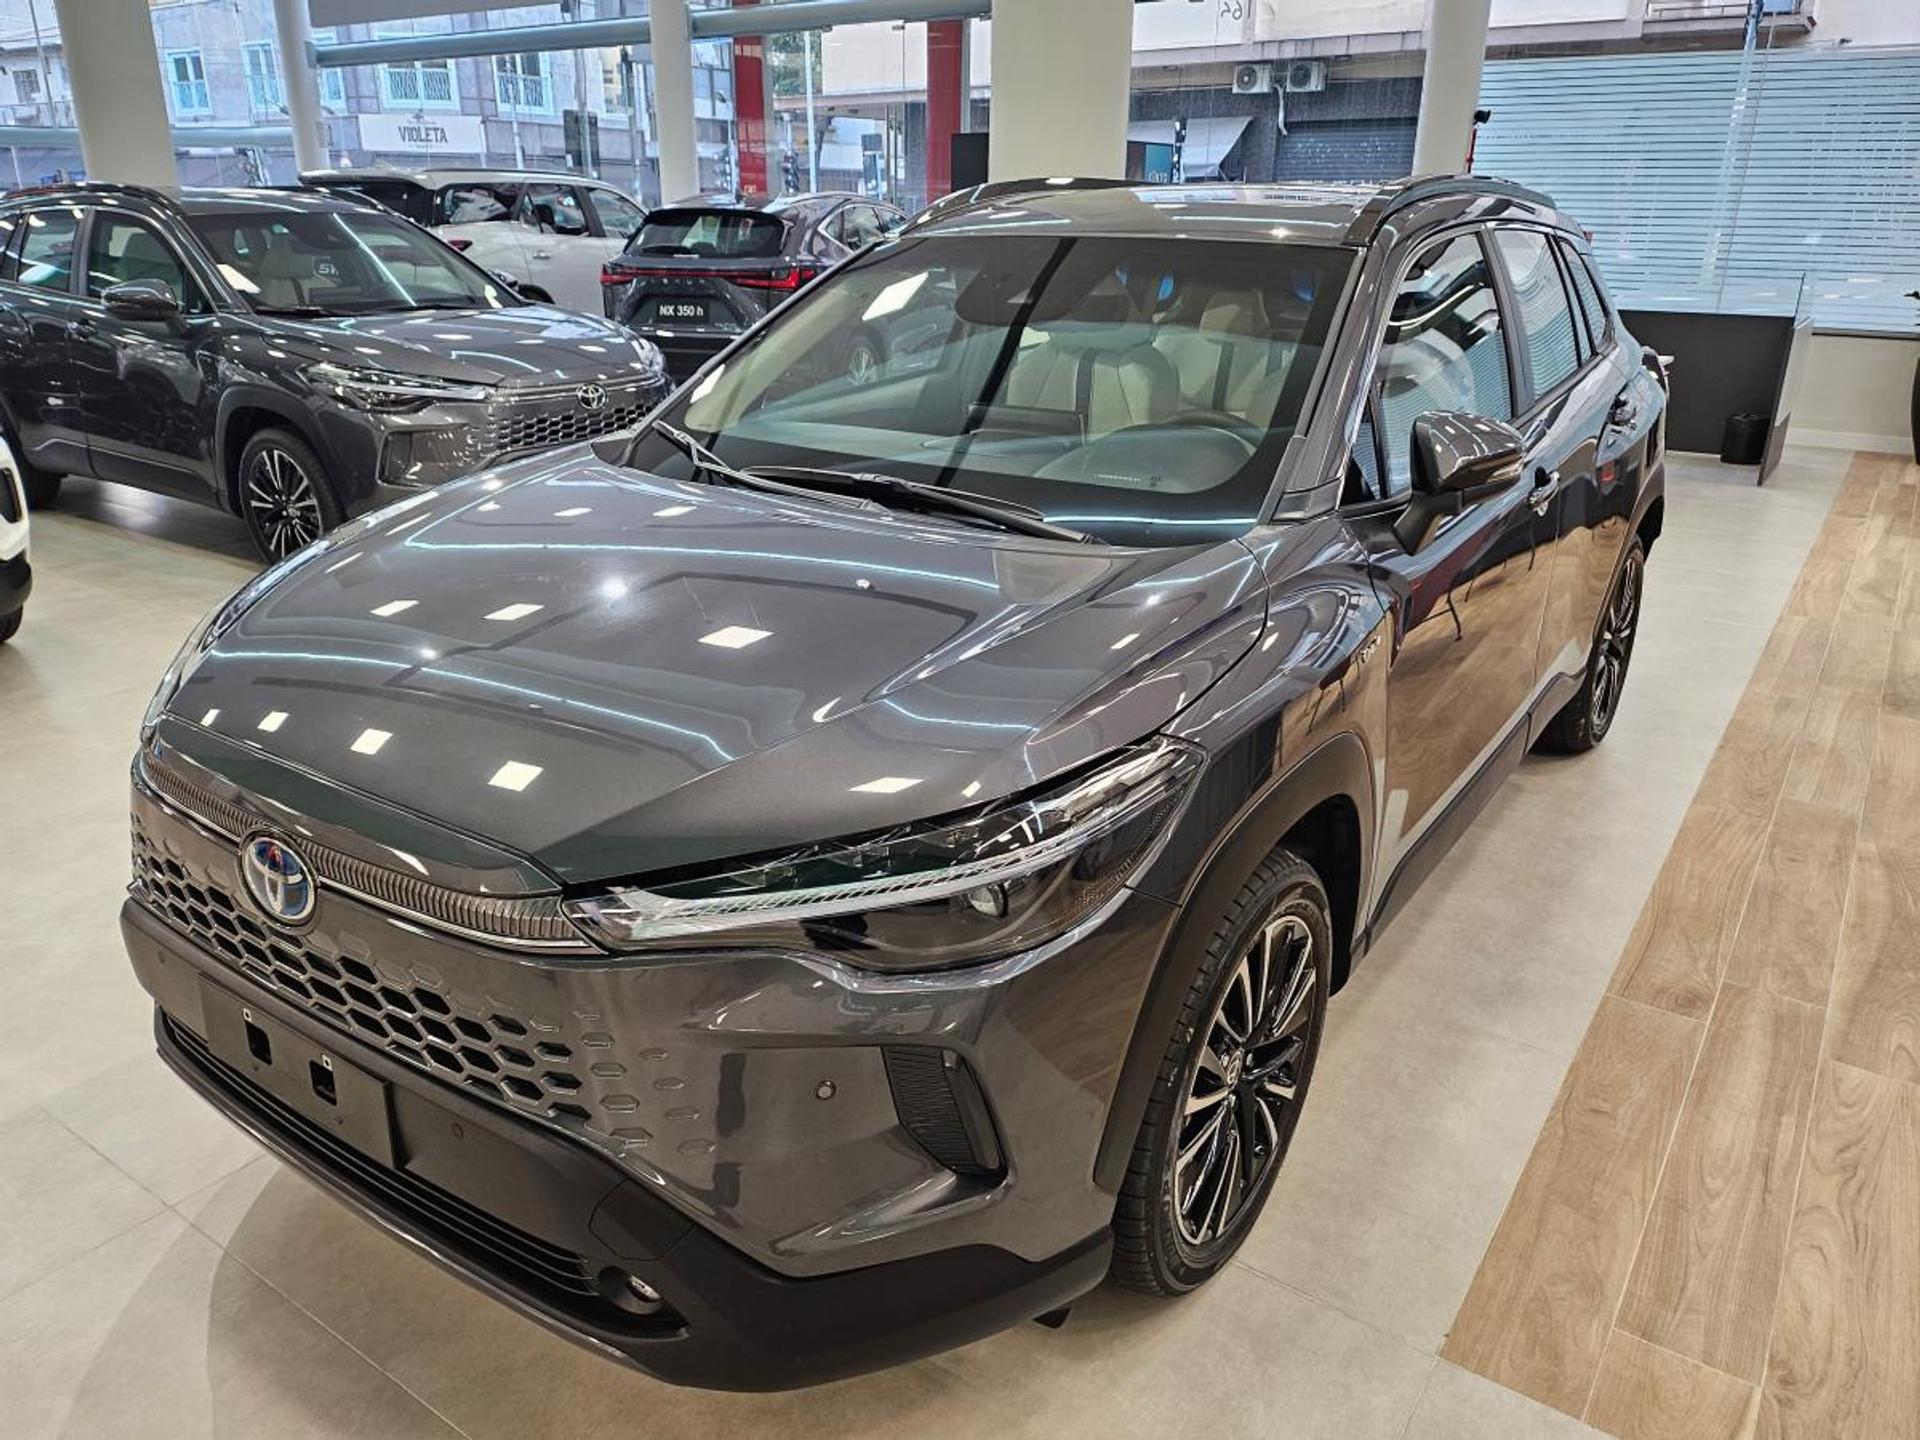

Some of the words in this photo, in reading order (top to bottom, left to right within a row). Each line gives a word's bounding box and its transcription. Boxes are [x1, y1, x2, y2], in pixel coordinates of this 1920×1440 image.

[398, 125, 448, 142] VIOLETA
[659, 304, 675, 316] NX
[676, 304, 695, 316] 350
[696, 304, 704, 316] h
